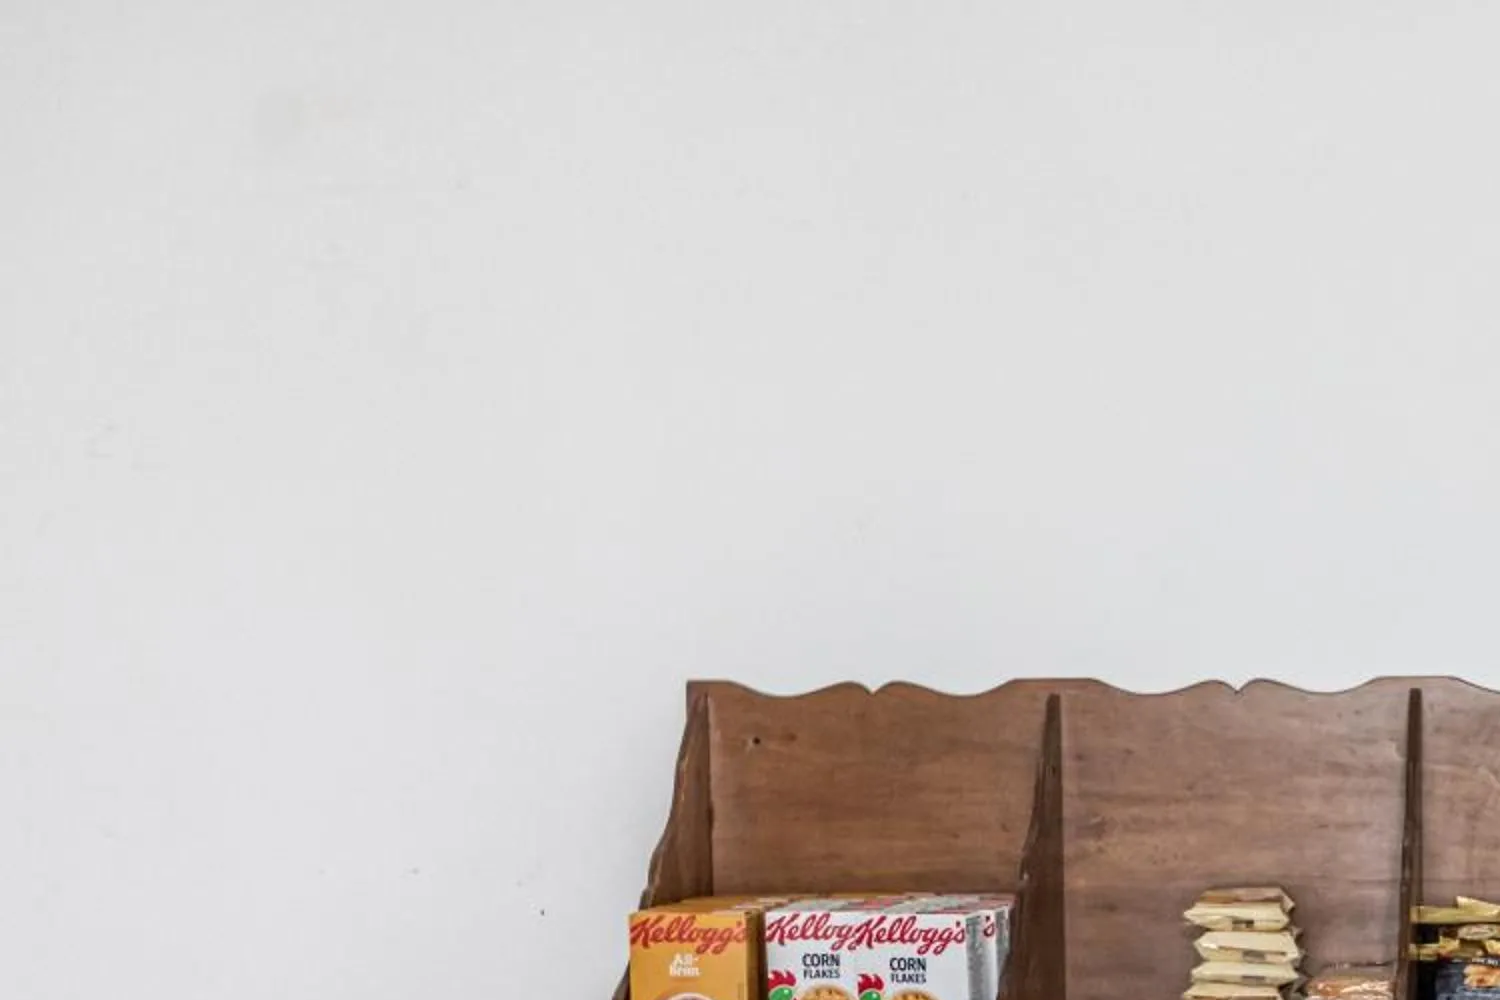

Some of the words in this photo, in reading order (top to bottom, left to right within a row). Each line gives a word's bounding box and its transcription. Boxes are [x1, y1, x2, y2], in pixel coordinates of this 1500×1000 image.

[630, 914, 747, 954] Kellogg's
[855, 915, 965, 955] Kellogg's
[802, 953, 840, 967] CORN
[889, 957, 926, 972] CORN
[803, 967, 840, 980] FLAKES
[890, 972, 926, 984] FLAKES
